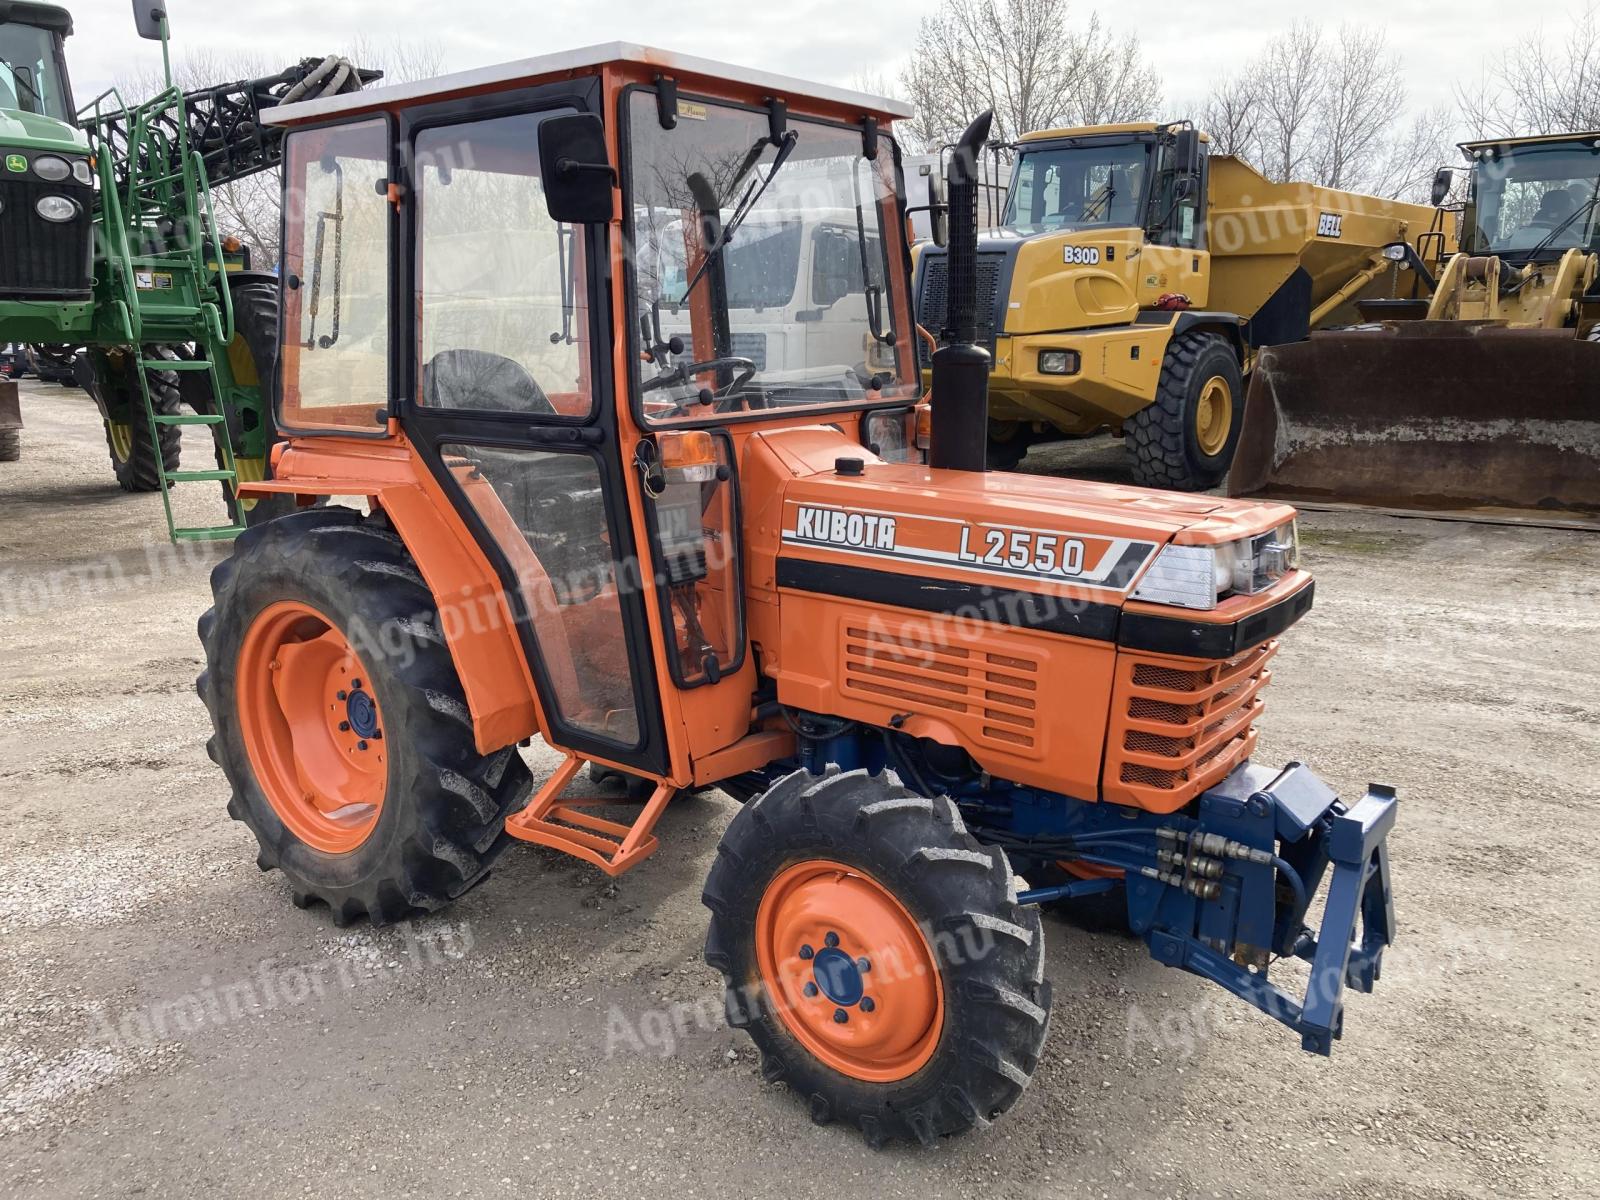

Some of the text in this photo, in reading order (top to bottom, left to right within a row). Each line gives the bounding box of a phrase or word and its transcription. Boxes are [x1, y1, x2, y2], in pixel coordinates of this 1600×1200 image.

[1317, 212, 1342, 238] BELL
[1063, 245, 1100, 265] B30D
[796, 505, 896, 550] KUBOTA
[957, 525, 1086, 577] L2550
